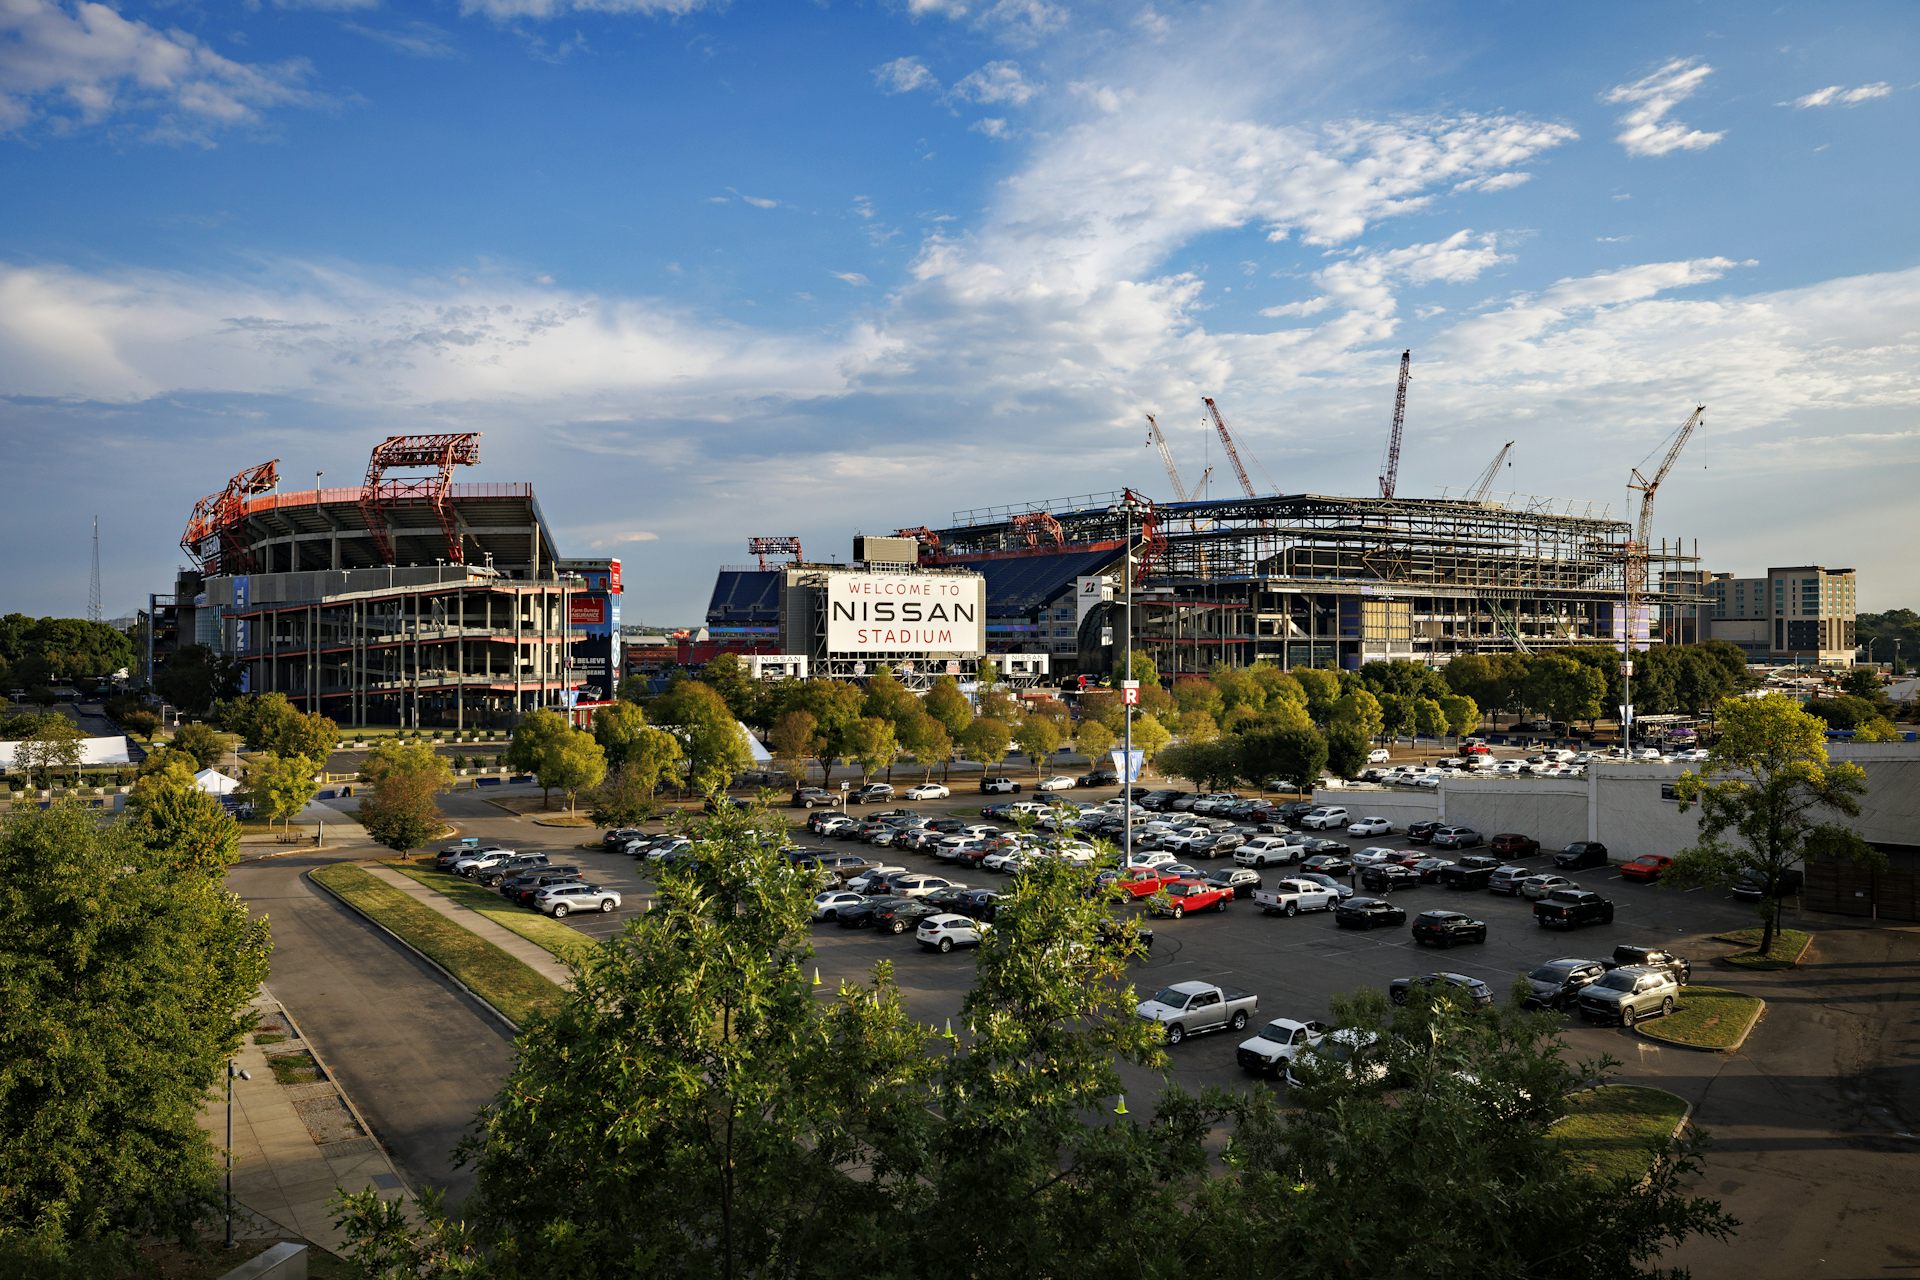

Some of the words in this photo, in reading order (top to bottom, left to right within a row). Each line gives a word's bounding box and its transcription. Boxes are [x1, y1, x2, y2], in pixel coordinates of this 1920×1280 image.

[849, 583, 931, 595] WELCOME
[940, 585, 960, 596] TO
[833, 601, 974, 622] NISSAN
[236, 587, 244, 653] TIAN
[858, 629, 952, 644] STADIUM
[1126, 688, 1136, 703] R
